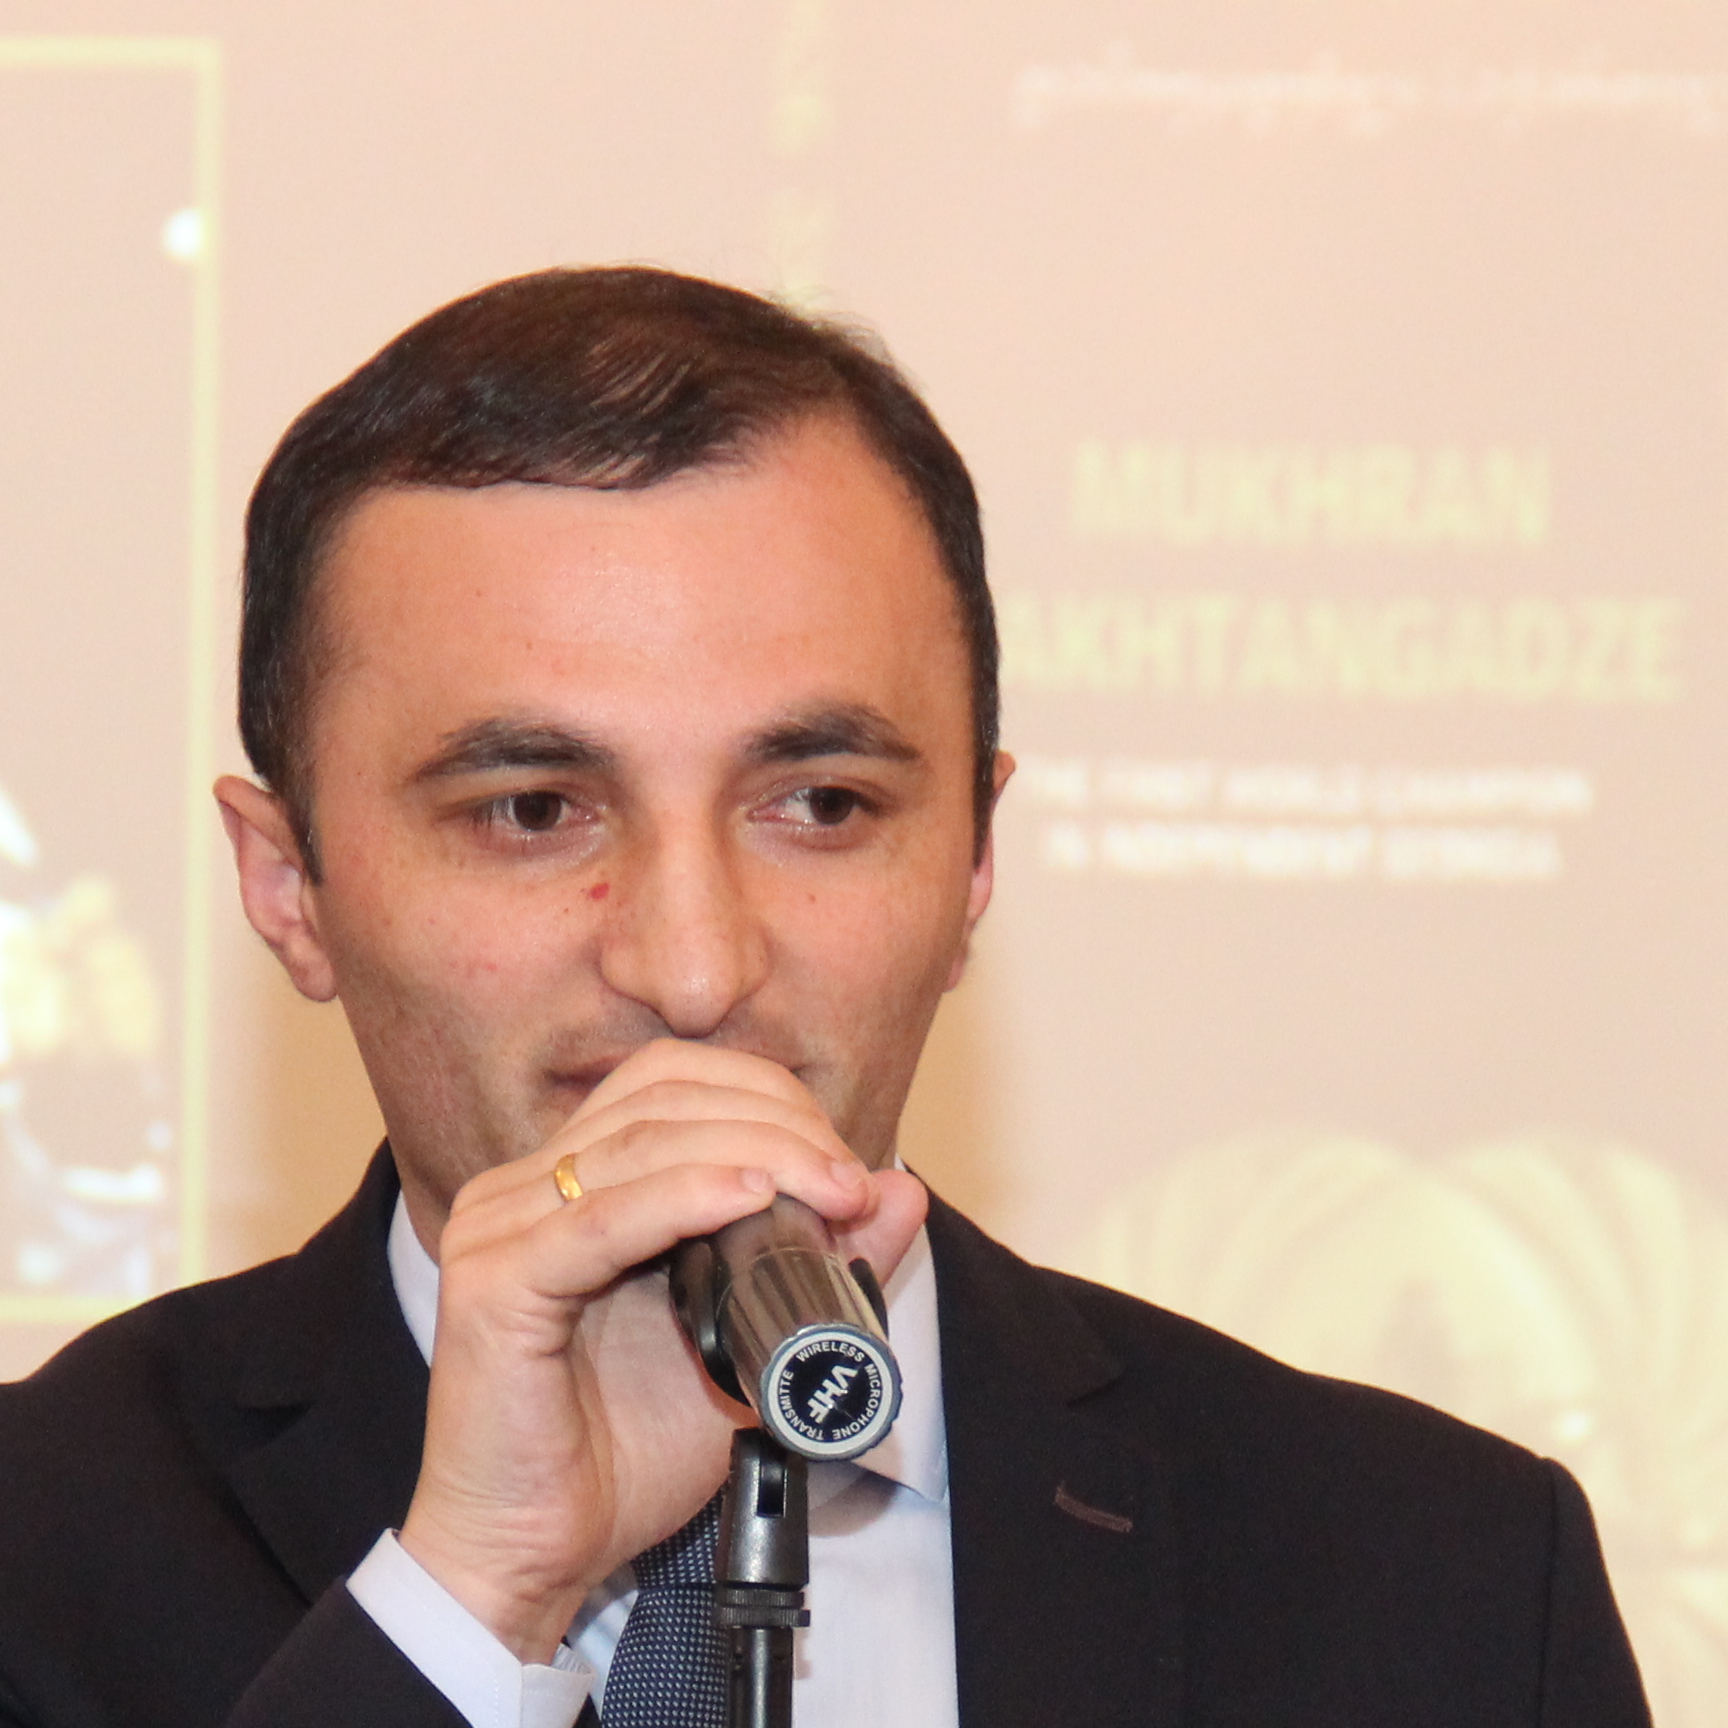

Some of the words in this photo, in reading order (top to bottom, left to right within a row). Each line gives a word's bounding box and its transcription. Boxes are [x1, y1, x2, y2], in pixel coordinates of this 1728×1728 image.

[1072, 440, 1552, 547] MUKHRAN
[796, 1341, 865, 1362] WIRELESS
[831, 1363, 882, 1440] MICROPHONE
[807, 1365, 859, 1424] VHF
